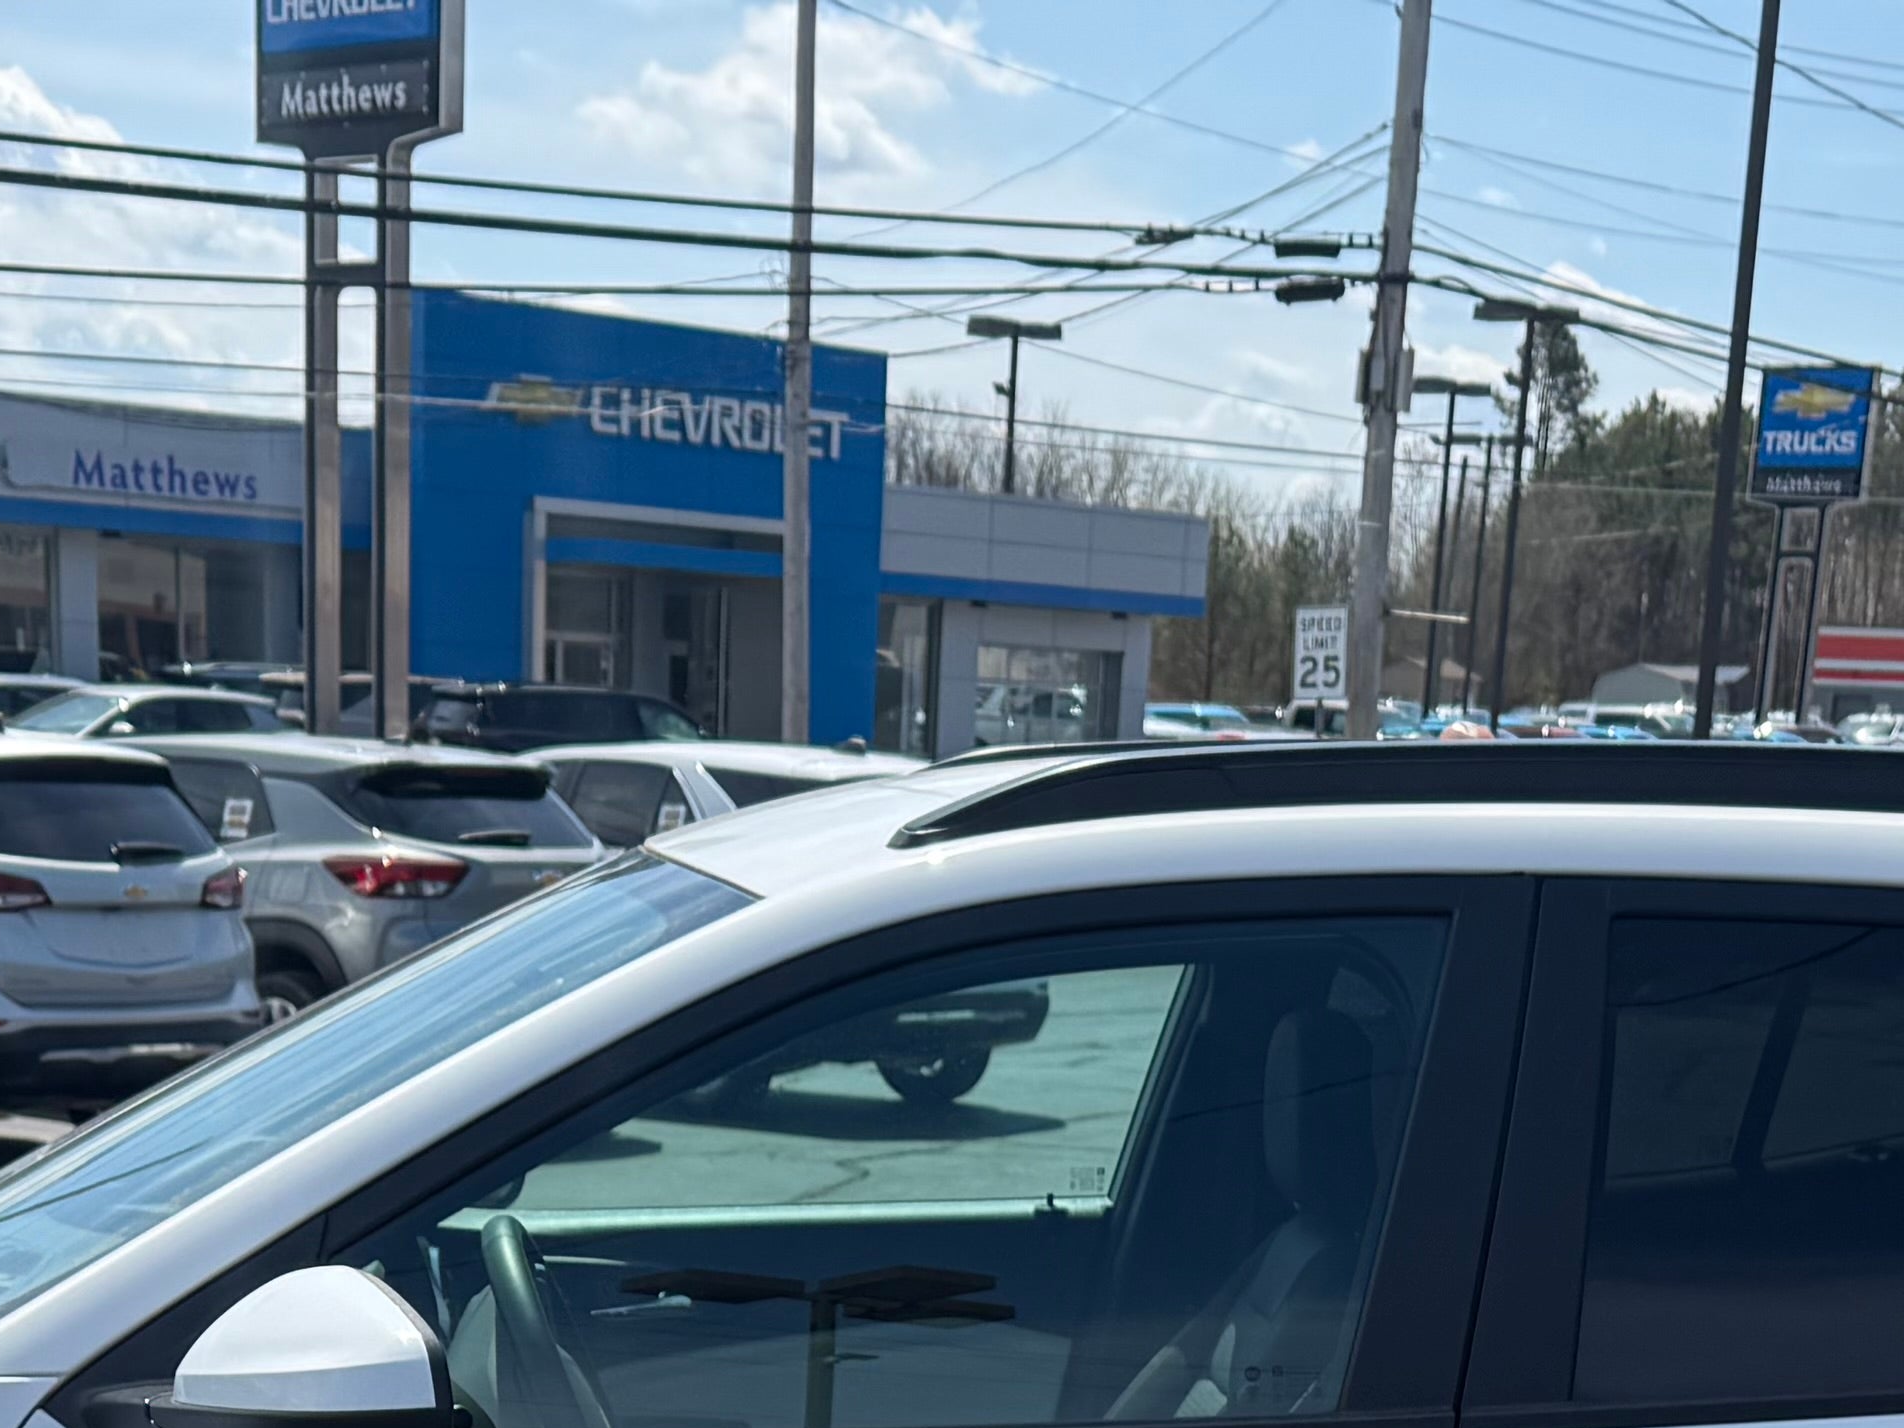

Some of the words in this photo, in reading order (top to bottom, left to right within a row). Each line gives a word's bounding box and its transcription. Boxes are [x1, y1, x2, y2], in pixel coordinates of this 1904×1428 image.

[280, 73, 408, 120] Matthews
[1762, 428, 1858, 455] TRUCKS
[72, 447, 258, 500] Matthews
[1300, 615, 1342, 633] SPEED
[1302, 635, 1338, 651] LIMIT
[1299, 655, 1341, 689] 25
